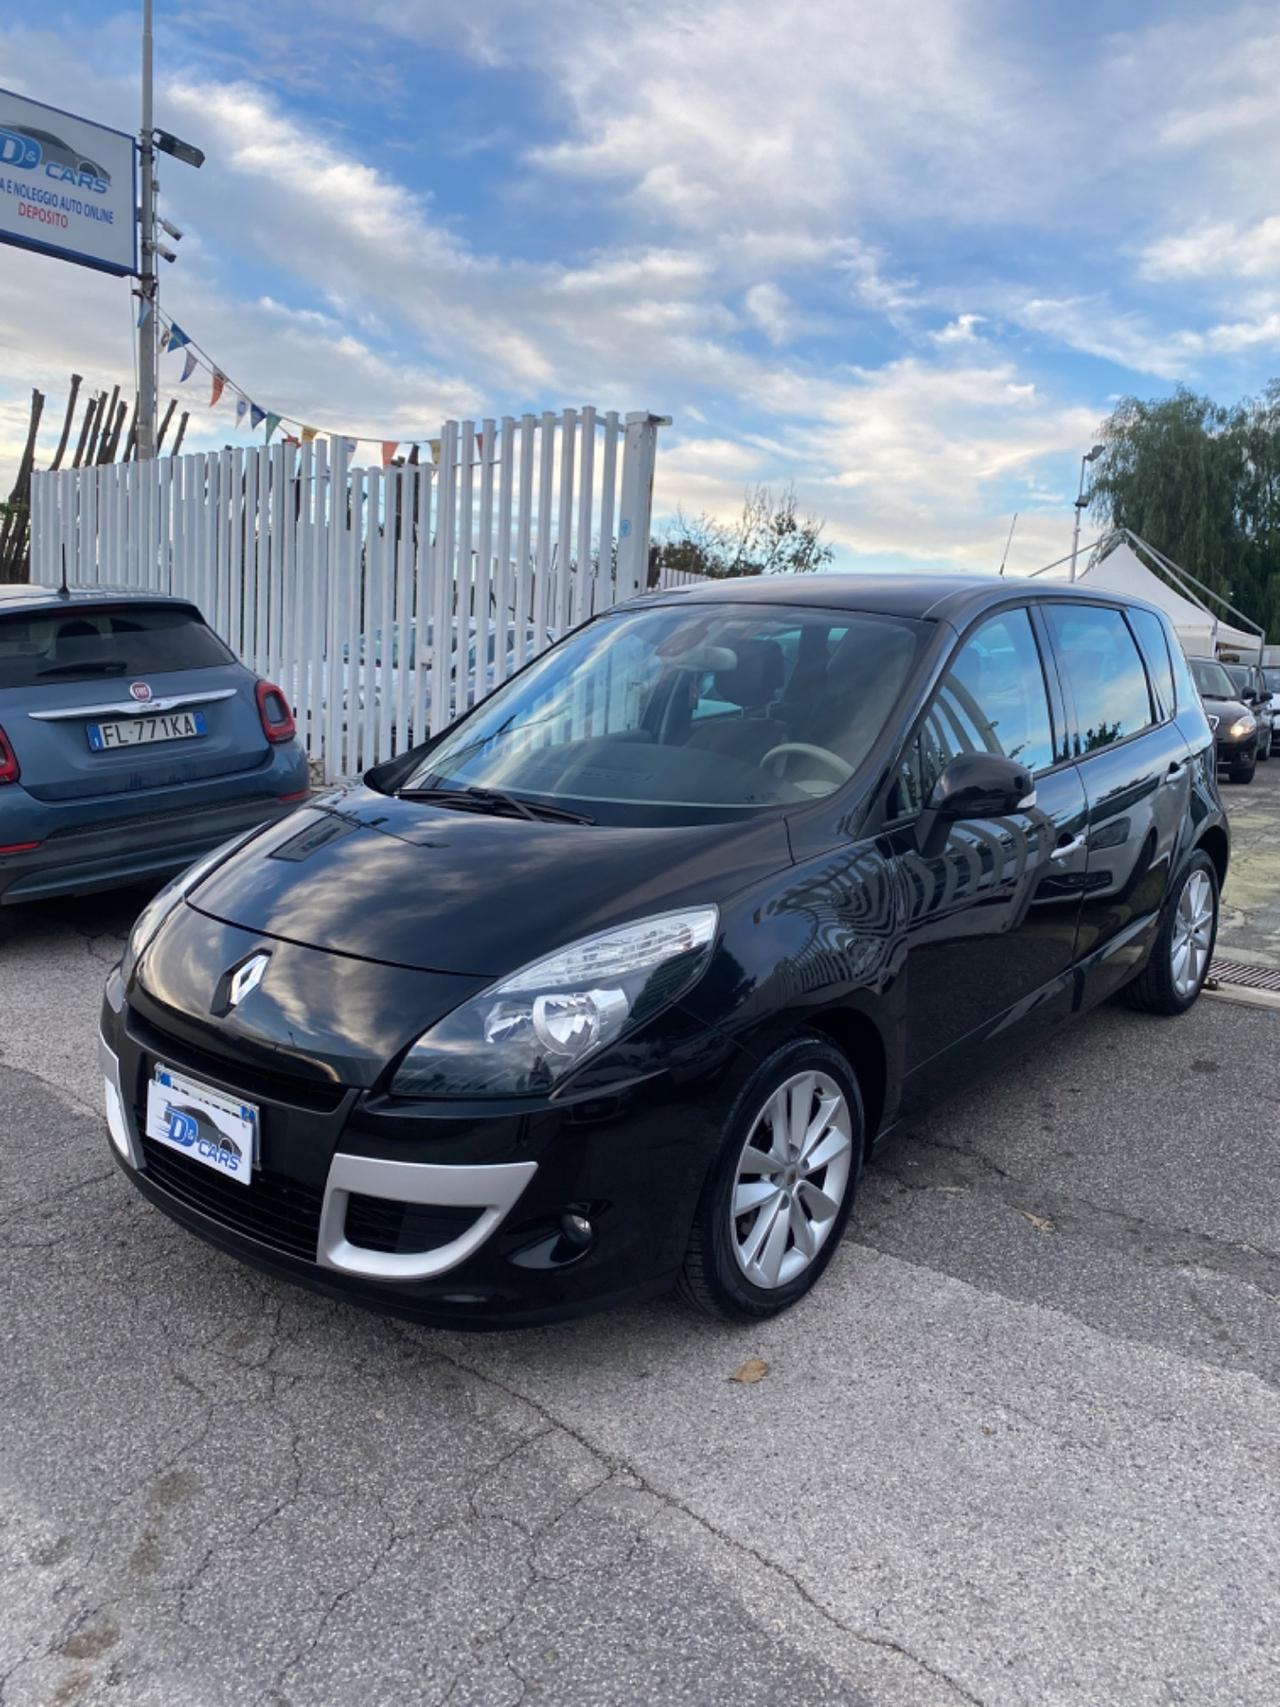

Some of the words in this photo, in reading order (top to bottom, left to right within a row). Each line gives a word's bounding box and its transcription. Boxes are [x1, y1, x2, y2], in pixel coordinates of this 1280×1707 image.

[45, 162, 108, 194] CARS
[7, 181, 13, 194] E
[13, 183, 58, 208] NOLEGGIO
[59, 197, 82, 215] AUTO
[84, 203, 115, 225] ONLINE
[18, 202, 69, 228] DEPOSITO
[198, 1139, 239, 1171] CARS
